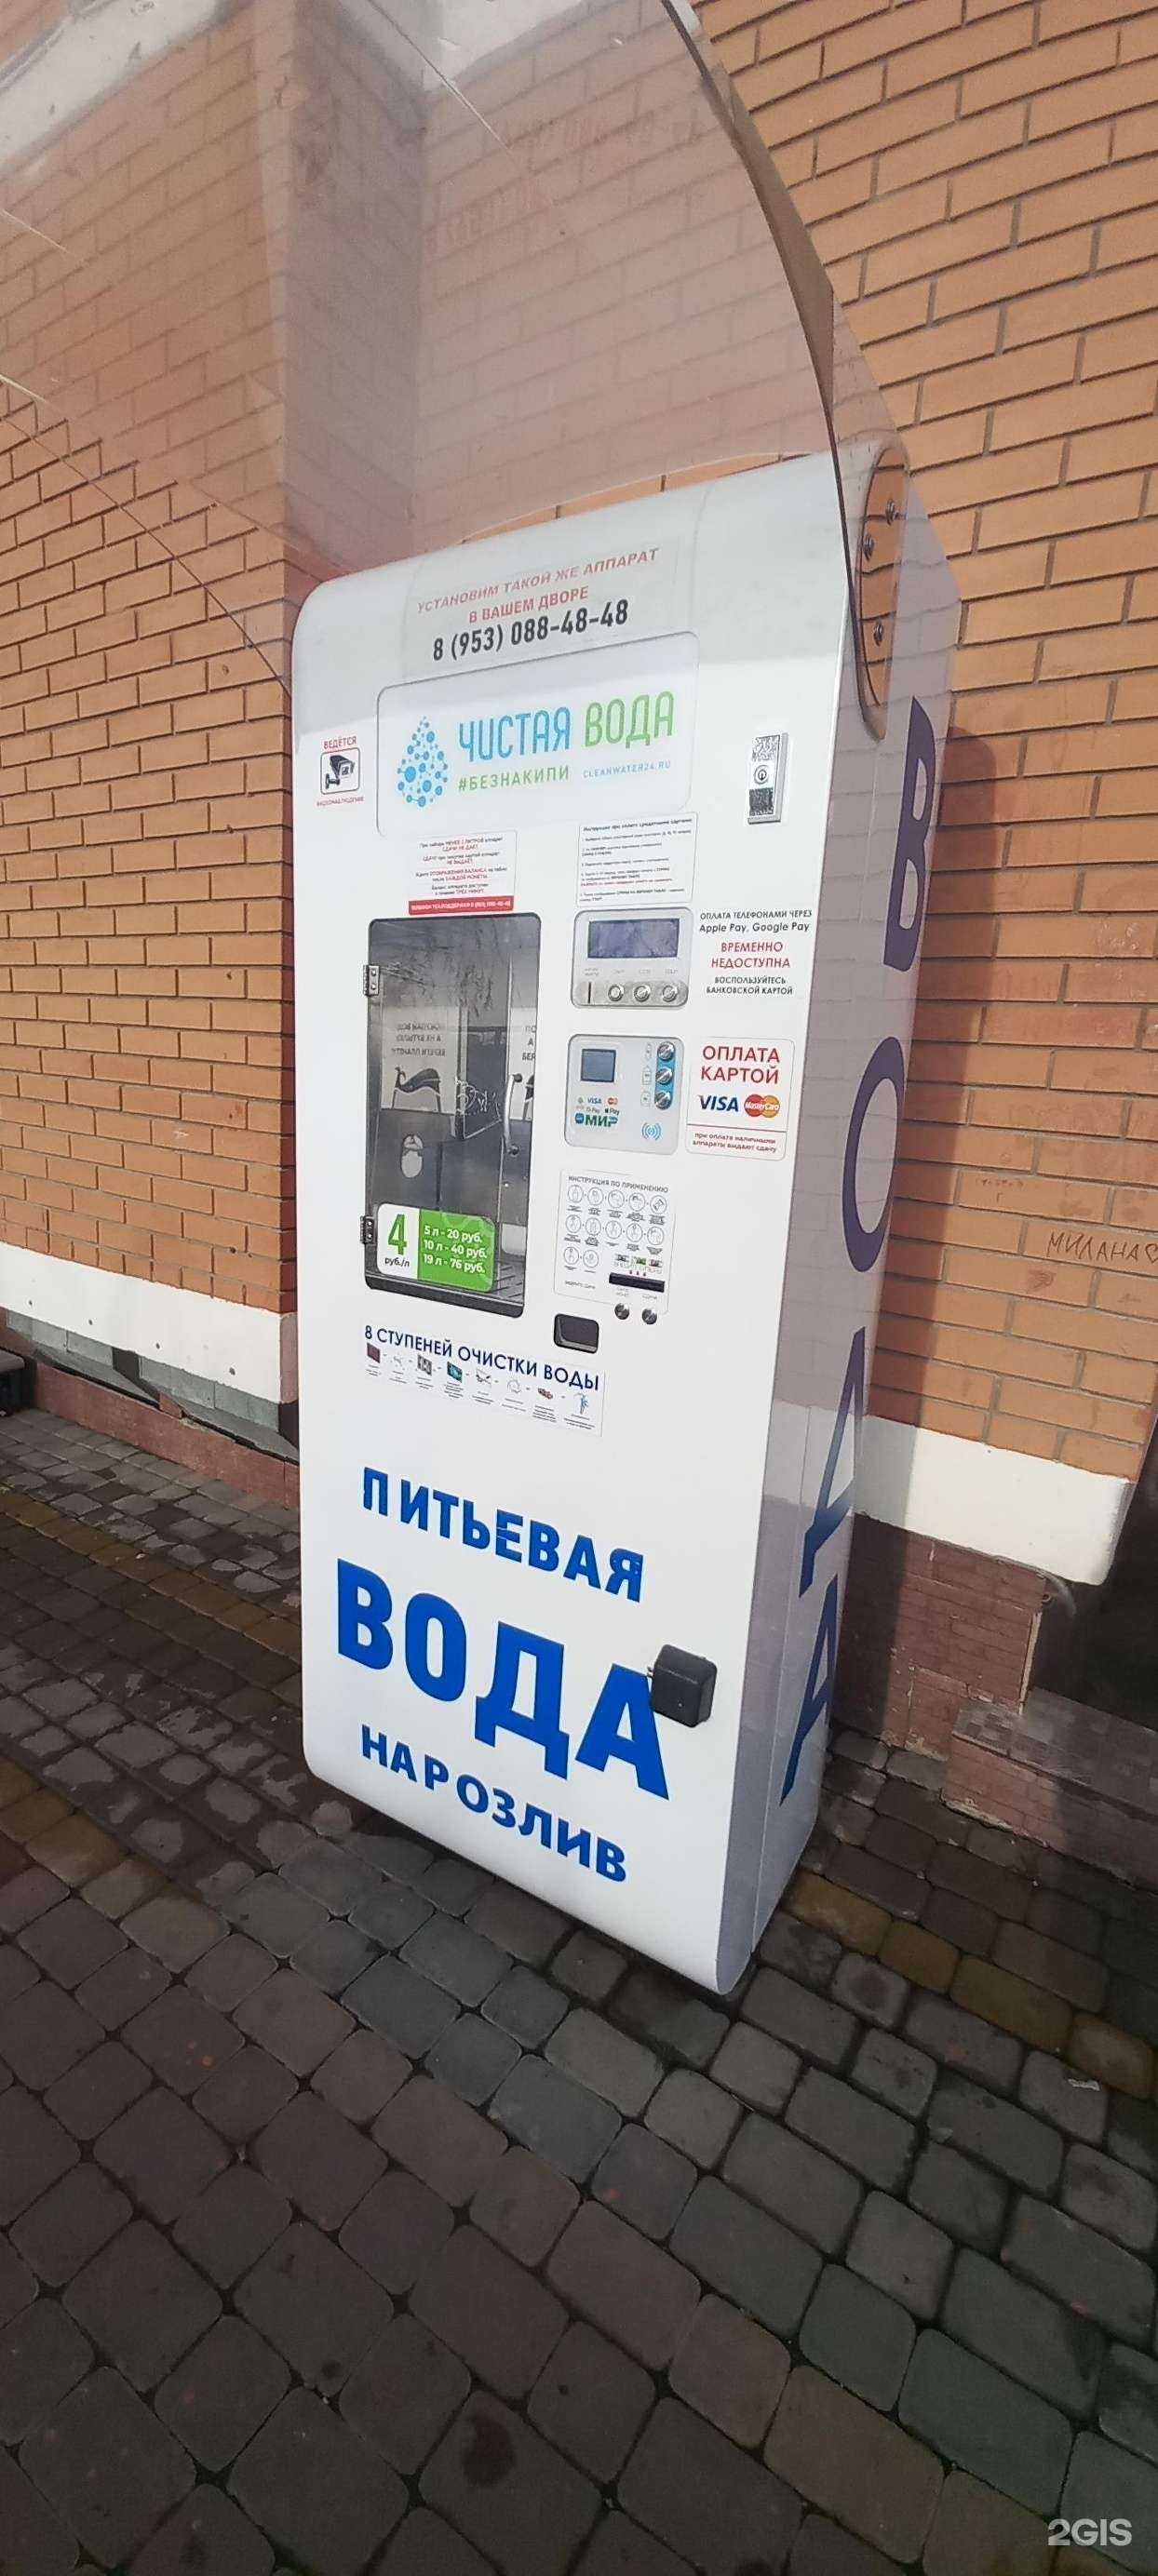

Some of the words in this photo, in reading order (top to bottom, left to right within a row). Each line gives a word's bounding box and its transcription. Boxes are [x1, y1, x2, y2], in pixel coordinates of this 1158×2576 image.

[418, 585, 498, 613] УСТАНОВИМ
[504, 570, 551, 593] ТАКОЙ
[555, 565, 579, 582] ЖЕ
[584, 548, 659, 575] АППАРАТ
[469, 610, 477, 623] В
[482, 597, 533, 621] ВАШЕМ
[538, 585, 588, 610] ДВОРЕ
[433, 637, 443, 661] 8
[451, 624, 504, 660] (953)
[512, 598, 628, 645] 088-48-48
[459, 706, 571, 762] ЧИСТАЯ
[585, 691, 674, 749] ВОДА
[458, 765, 570, 791] #БЕЗНАКИПИ
[700, 912, 731, 920] ОПЛАТА
[734, 910, 787, 919] ТЕЛЕФОНАМИ
[789, 909, 812, 918] ЧЕРЕЗ
[700, 924, 726, 933] Apple
[752, 922, 788, 933] Google
[791, 921, 809, 932] Pay
[720, 941, 783, 952] ВРЕМЕННО
[711, 958, 790, 969] НЕДОСТУПНА
[715, 975, 786, 984] ВОСПОЛЬЗУЙТЕСЬ
[707, 985, 760, 994] БАНКОВСКОЙ
[761, 986, 792, 995] КАРТОЙ
[703, 1045, 780, 1063] ОПЛАТА
[701, 1065, 779, 1084] КАРТОЙ
[698, 1094, 739, 1112] VISA
[586, 1114, 618, 1127] МИР
[568, 1175, 610, 1186] ИНСТРУКЦИЯ
[621, 1182, 669, 1193] ПРИМЕНЕНИЮ
[387, 1214, 408, 1255] 4
[424, 1226, 430, 1235] 5
[447, 1228, 459, 1239] 20
[461, 1231, 483, 1243] руб.
[424, 1240, 434, 1249] 10
[451, 1243, 464, 1254] 40
[466, 1247, 488, 1259] руб.
[1046, 1230, 1139, 1262] МИЛАНА
[384, 1258, 411, 1268] руб./л
[424, 1254, 434, 1264] 19
[450, 1258, 463, 1268] 76
[464, 1261, 486, 1274] руб.
[364, 1324, 373, 1340] 8
[376, 1328, 453, 1358] СТУПЕНЕЙ
[457, 1346, 538, 1377] ОЧИСТКИ
[544, 1363, 599, 1391] ВОДЫ
[362, 1466, 644, 1603] ПИТЬЕВАЯ
[337, 1558, 670, 1801] ВОДА
